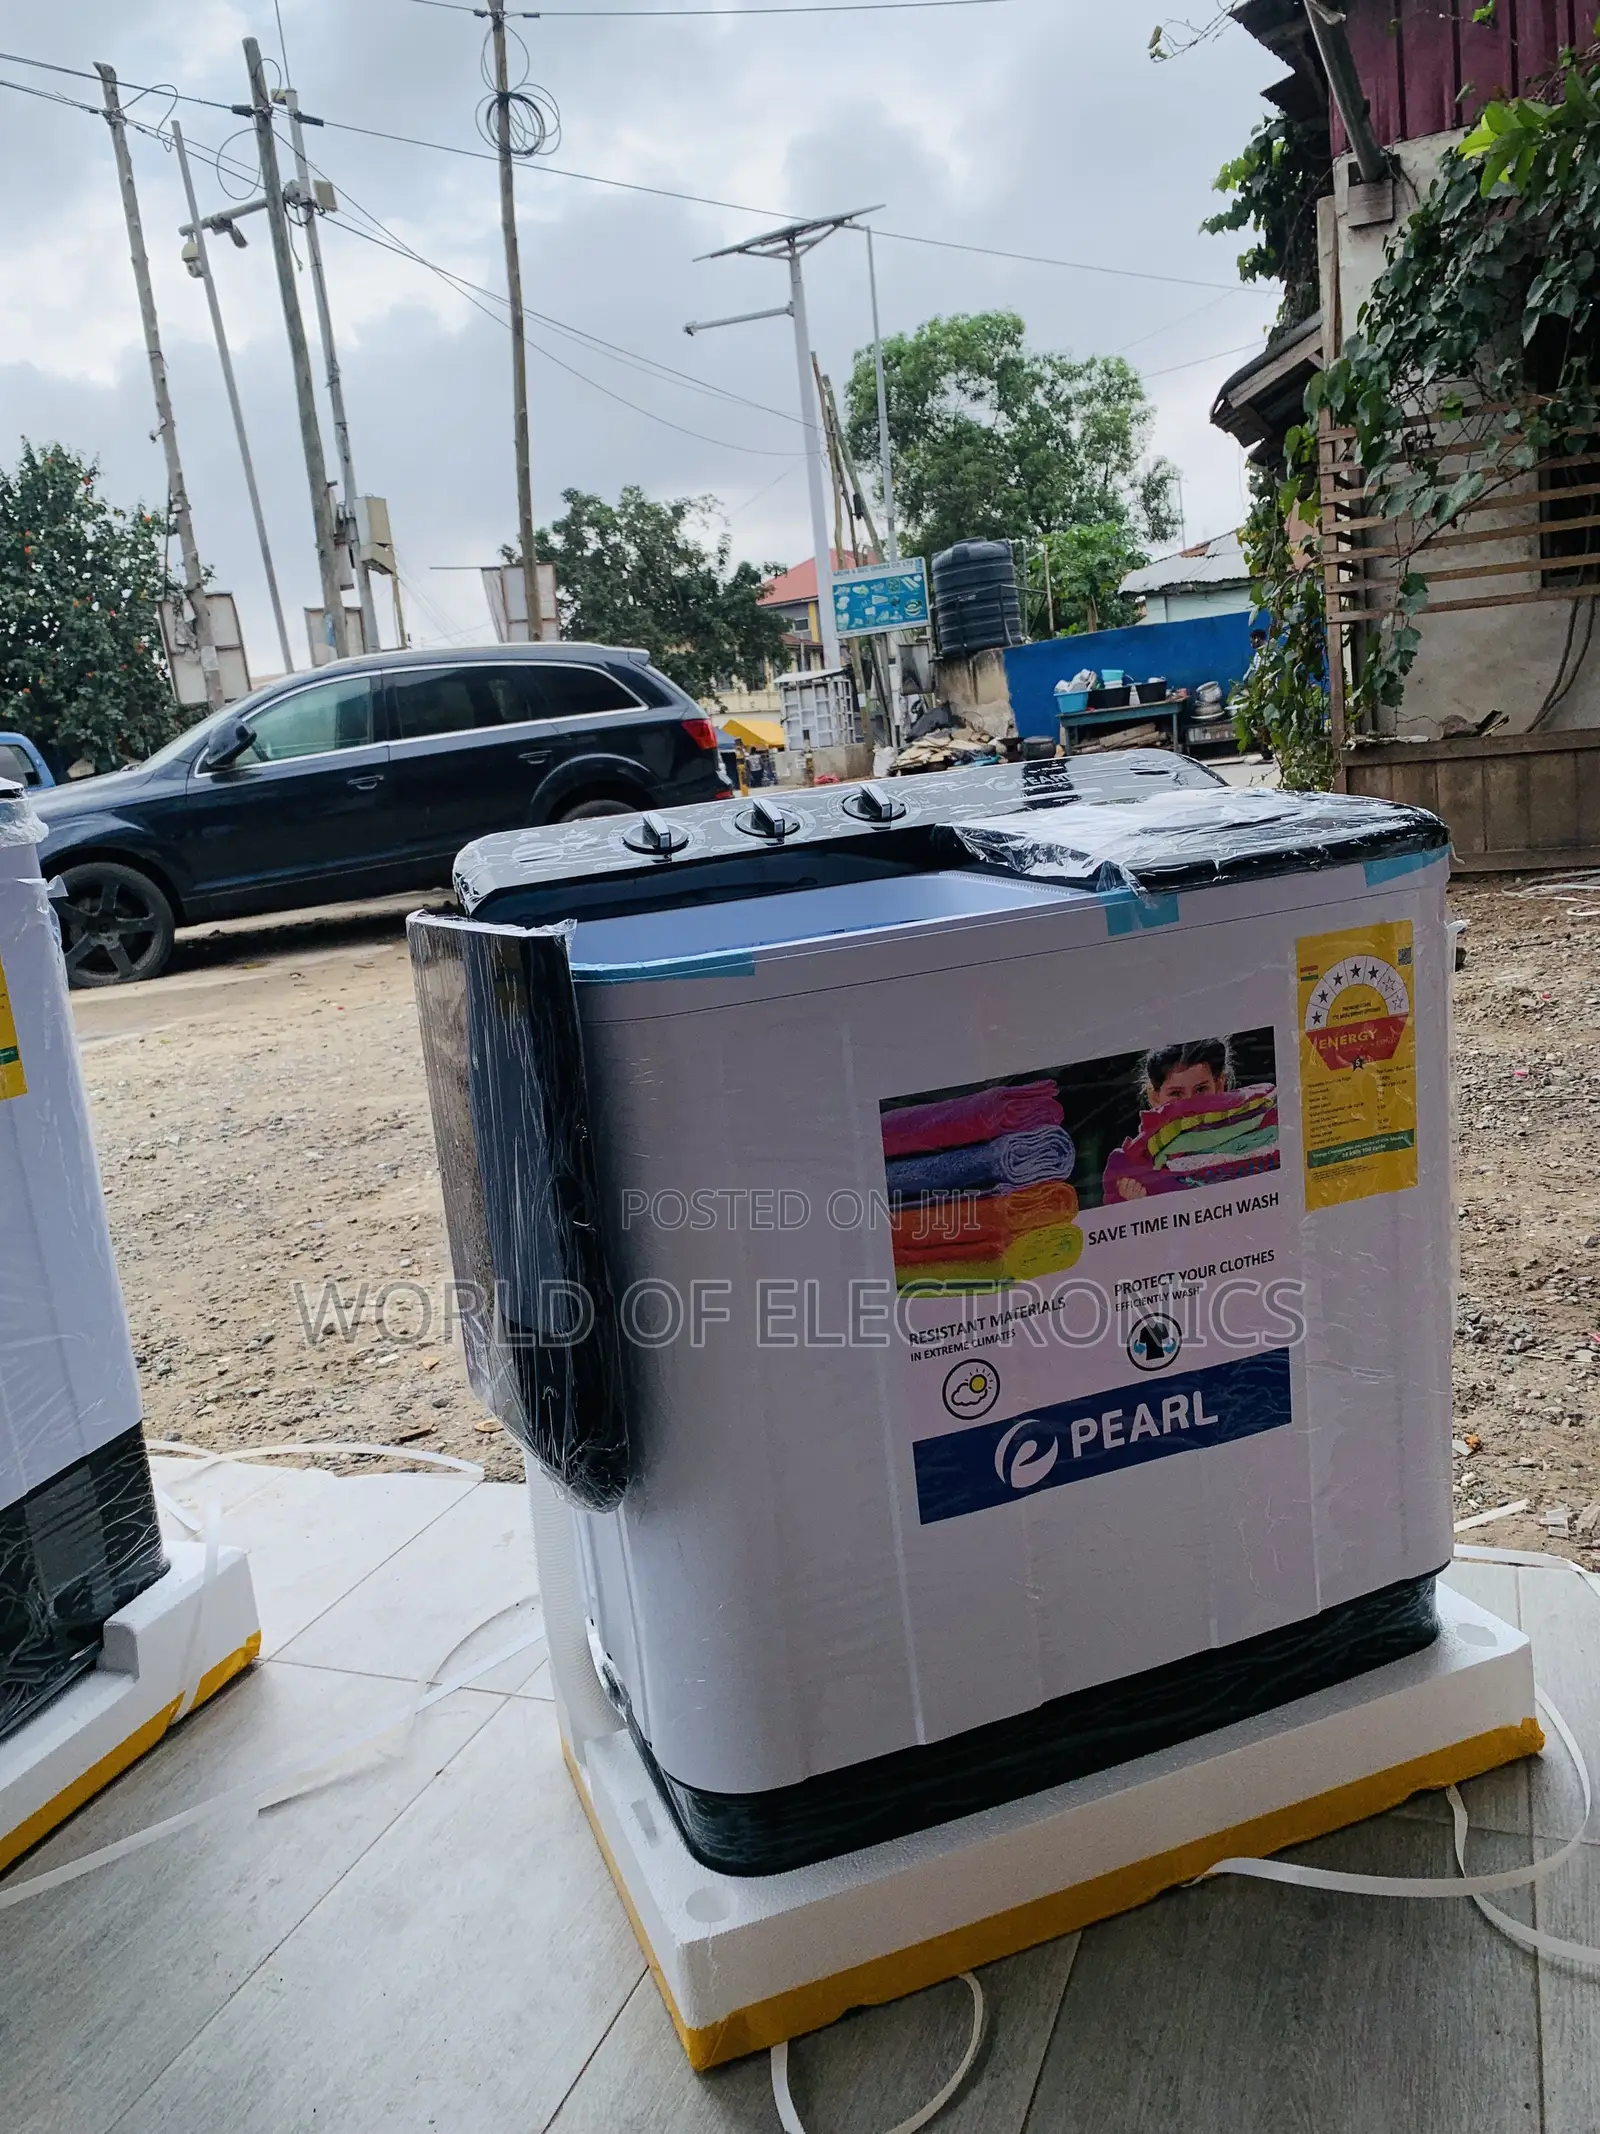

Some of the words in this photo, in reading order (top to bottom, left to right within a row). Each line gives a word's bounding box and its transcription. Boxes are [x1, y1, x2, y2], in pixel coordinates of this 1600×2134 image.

[1319, 1028, 1378, 1050] ENERGY
[1087, 1221, 1127, 1246] SAVE
[1130, 1213, 1168, 1239] TIME
[1173, 1211, 1189, 1232] IN
[1194, 1203, 1232, 1229] EACH
[1236, 1192, 1279, 1221] WASH
[1114, 1273, 1173, 1297] PROTECT
[1178, 1264, 1217, 1285] YOUR
[1219, 1249, 1275, 1276] CLOTHES
[909, 1317, 985, 1346] RESISTANT
[989, 1297, 1066, 1326] MATERIALS
[1114, 1292, 1168, 1312] EFFICIENTLY
[1171, 1287, 1200, 1302] WASH
[910, 1351, 921, 1361] IN
[924, 1340, 969, 1360] EXTREME
[971, 1329, 1016, 1349] CLIMATES
[1070, 1389, 1218, 1458] PEARL
